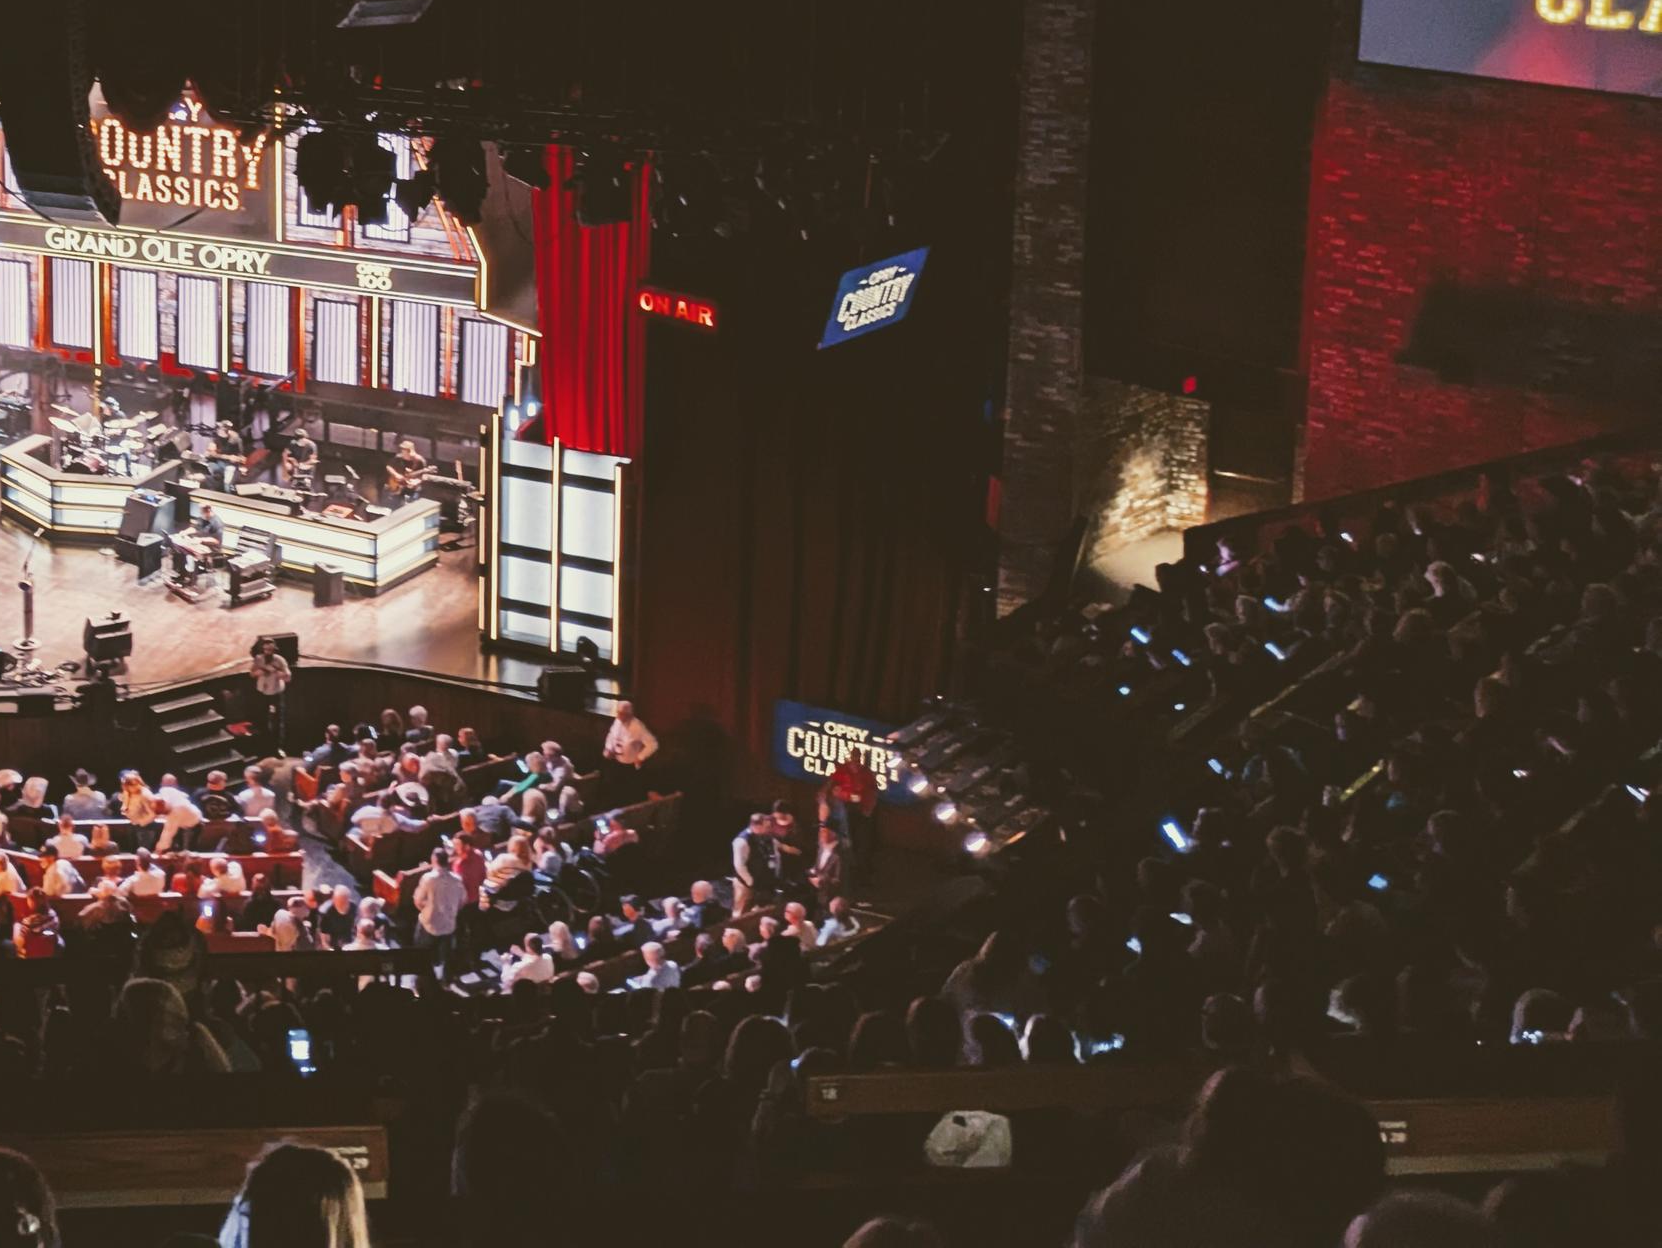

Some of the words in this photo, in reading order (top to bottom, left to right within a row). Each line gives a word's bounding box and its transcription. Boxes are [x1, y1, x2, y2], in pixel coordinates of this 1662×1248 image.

[91, 117, 268, 191] OUNTRY
[44, 227, 137, 258] GRAND
[141, 237, 194, 266] OLE
[198, 244, 271, 275] OPRY
[640, 292, 671, 316] ON
[674, 300, 714, 327] AIR
[837, 272, 915, 323] COUNTRY
[823, 720, 870, 743] OPRY
